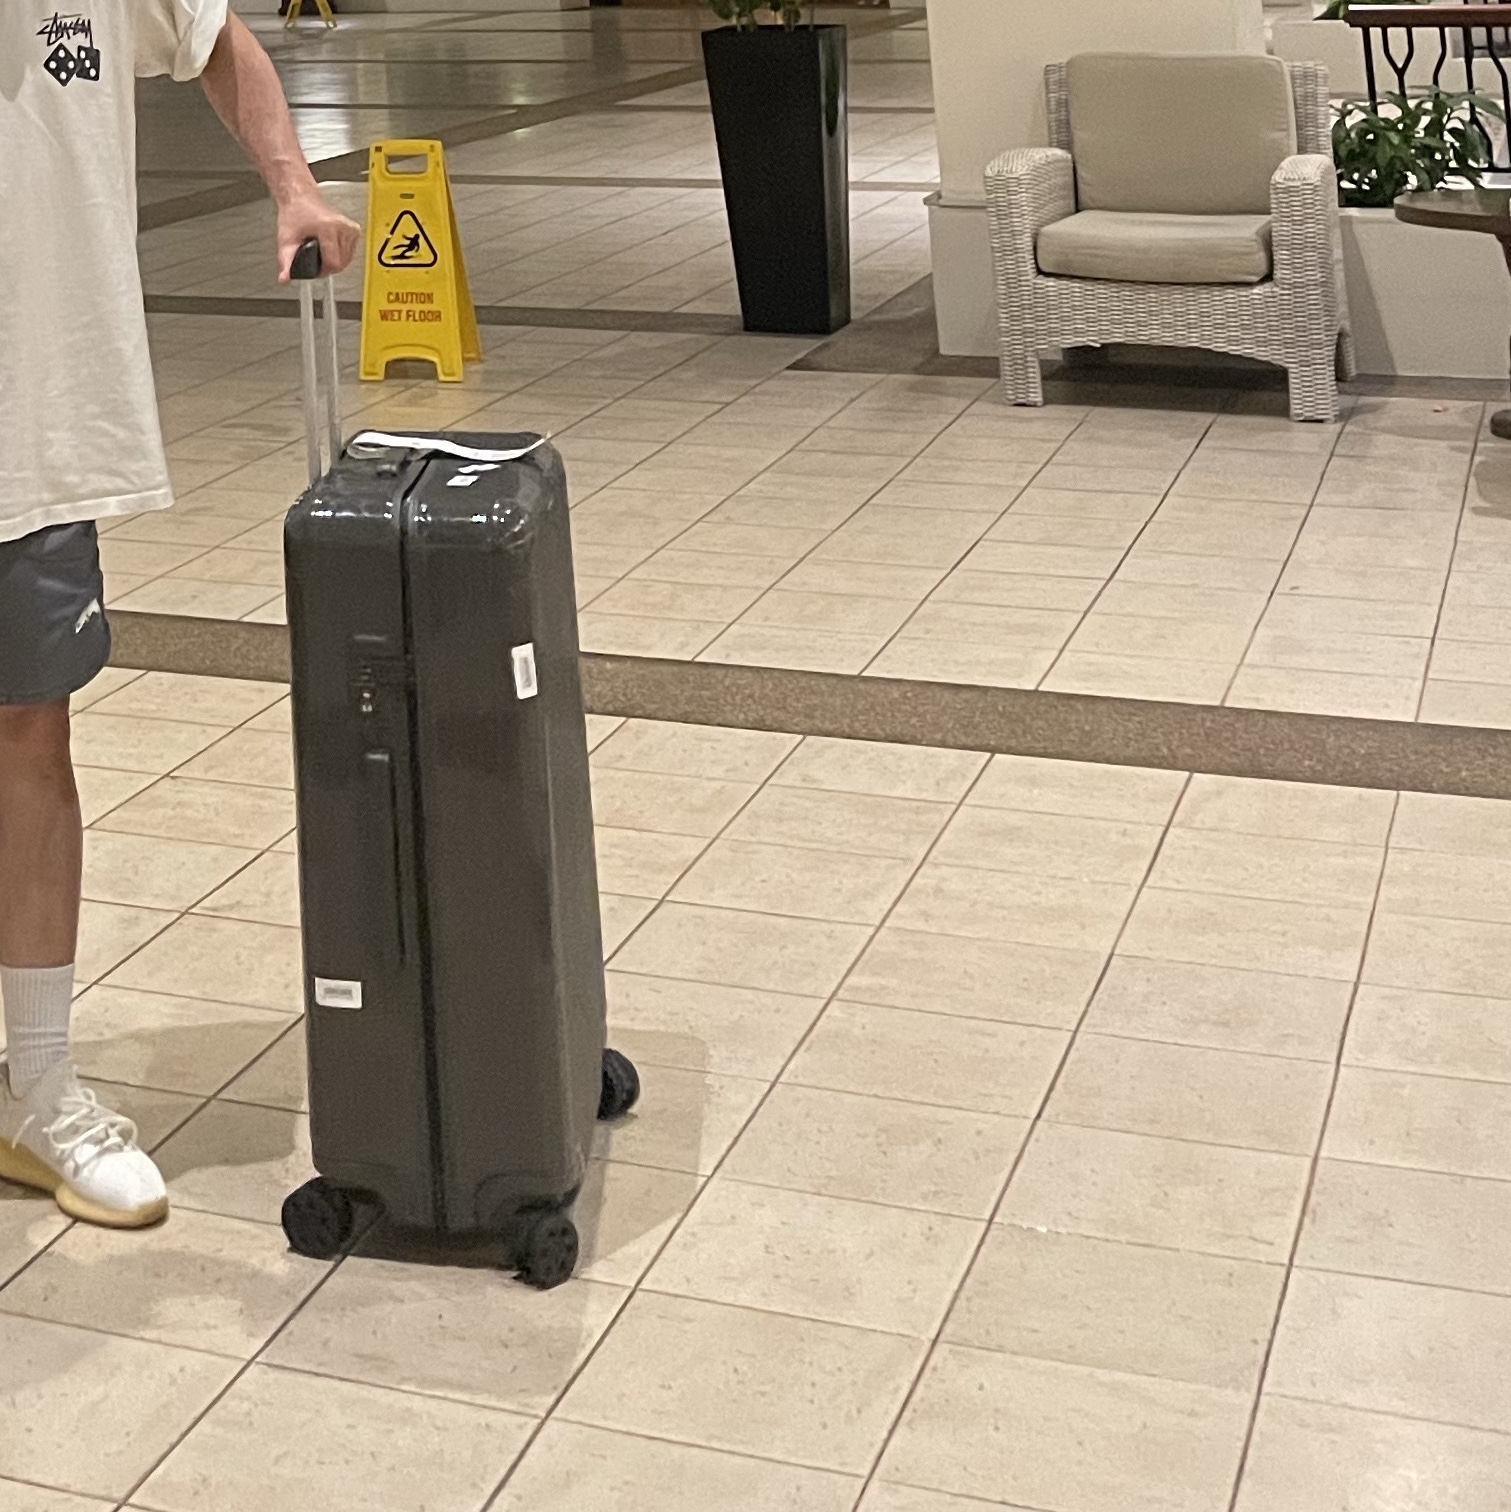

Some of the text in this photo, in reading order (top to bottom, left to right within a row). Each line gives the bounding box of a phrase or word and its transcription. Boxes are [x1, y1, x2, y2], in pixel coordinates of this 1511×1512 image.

[387, 291, 434, 304] CAUTION
[379, 309, 442, 323] WET FLOOR
